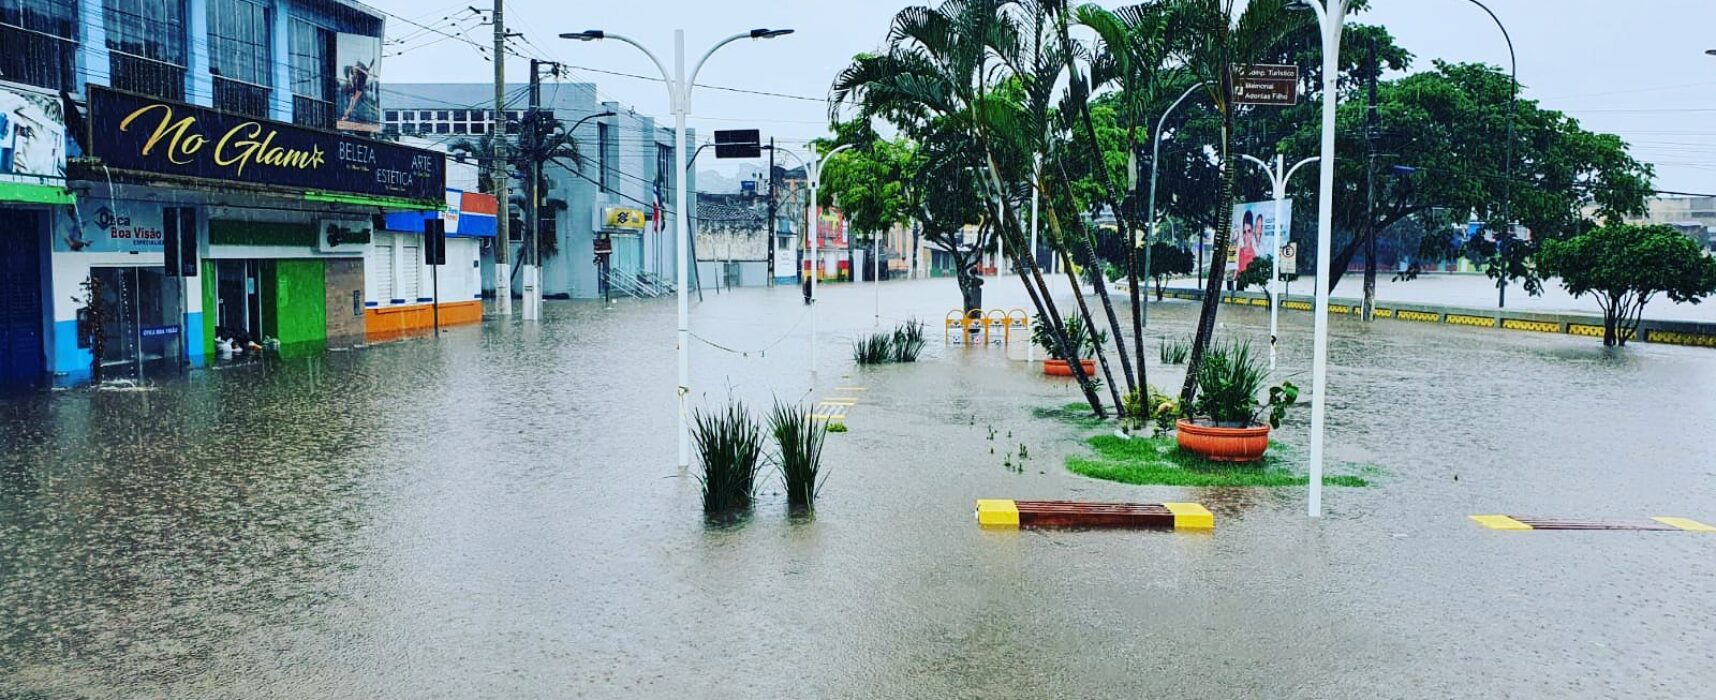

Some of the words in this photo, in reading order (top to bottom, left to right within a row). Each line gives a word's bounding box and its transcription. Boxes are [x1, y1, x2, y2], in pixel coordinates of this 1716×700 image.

[119, 104, 210, 165] No
[214, 121, 313, 177] Glam
[339, 141, 377, 165] BELEZA
[411, 154, 433, 173] ARTE
[111, 227, 131, 239] Boa
[134, 226, 161, 239] Visão
